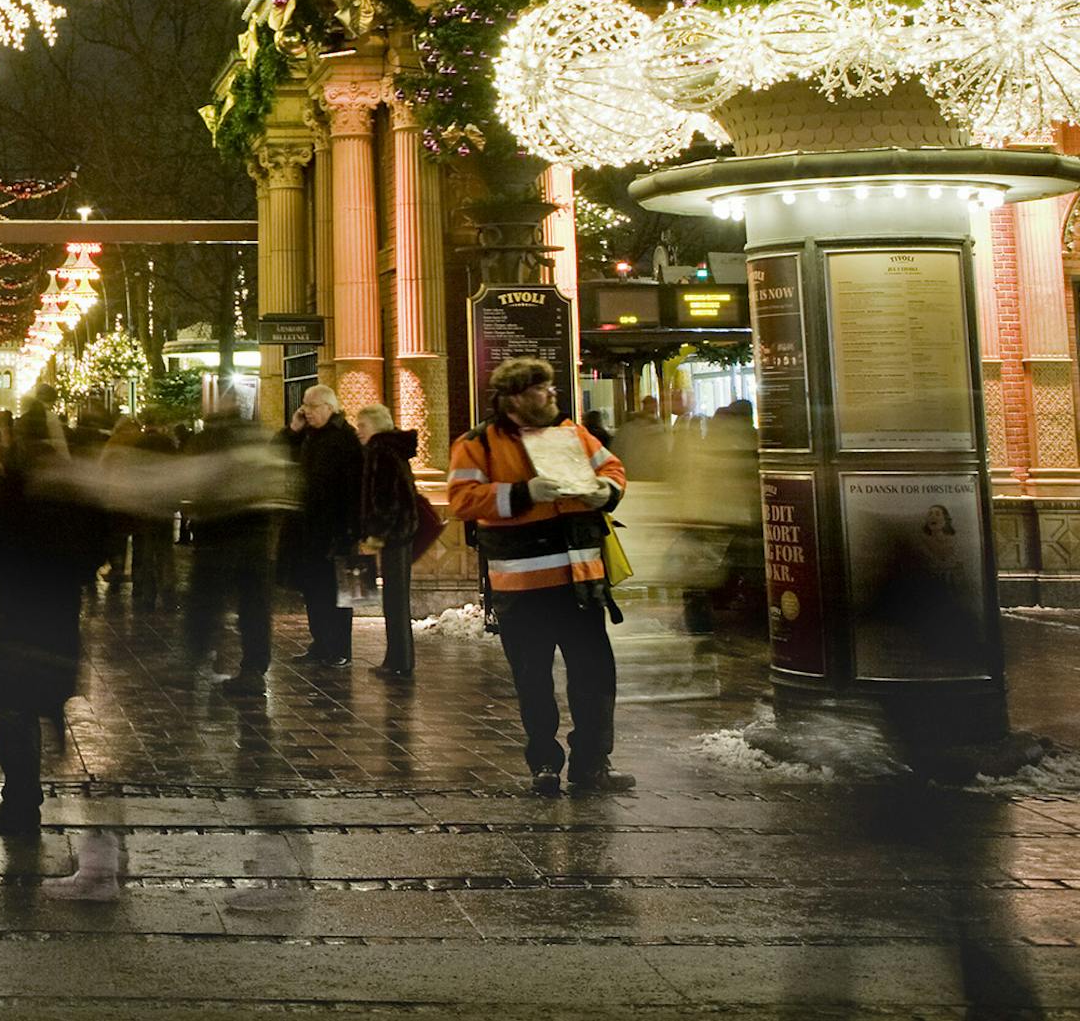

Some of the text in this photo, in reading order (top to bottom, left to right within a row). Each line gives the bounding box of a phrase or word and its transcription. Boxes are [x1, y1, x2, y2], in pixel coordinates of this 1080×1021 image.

[497, 291, 546, 305] TIVOLI
[768, 286, 795, 300] NOW
[865, 485, 897, 493] DANSK
[771, 505, 794, 523] DIT
[777, 545, 805, 563] FOR
[774, 563, 794, 582] KR.
